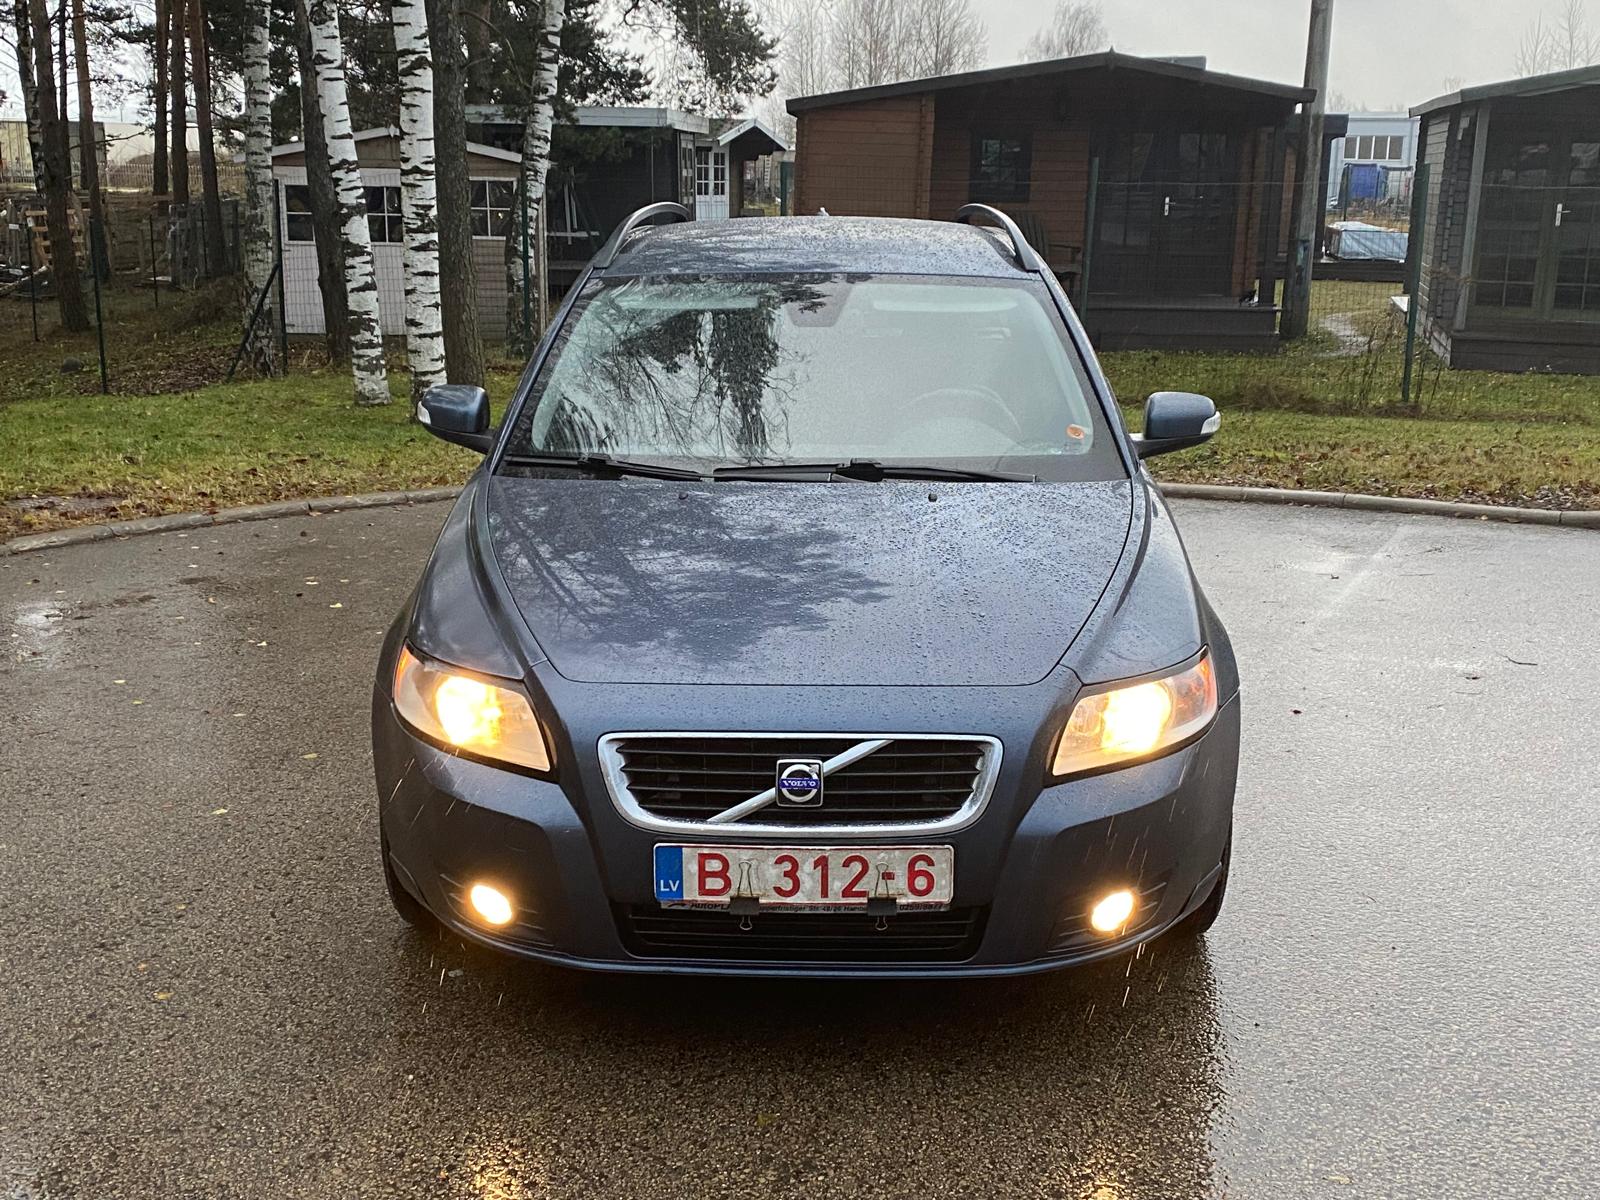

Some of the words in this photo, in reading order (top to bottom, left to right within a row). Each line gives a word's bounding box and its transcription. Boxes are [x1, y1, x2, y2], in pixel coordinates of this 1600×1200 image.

[660, 879, 680, 892] LV
[697, 852, 732, 897] B
[773, 853, 935, 898] 312-6
